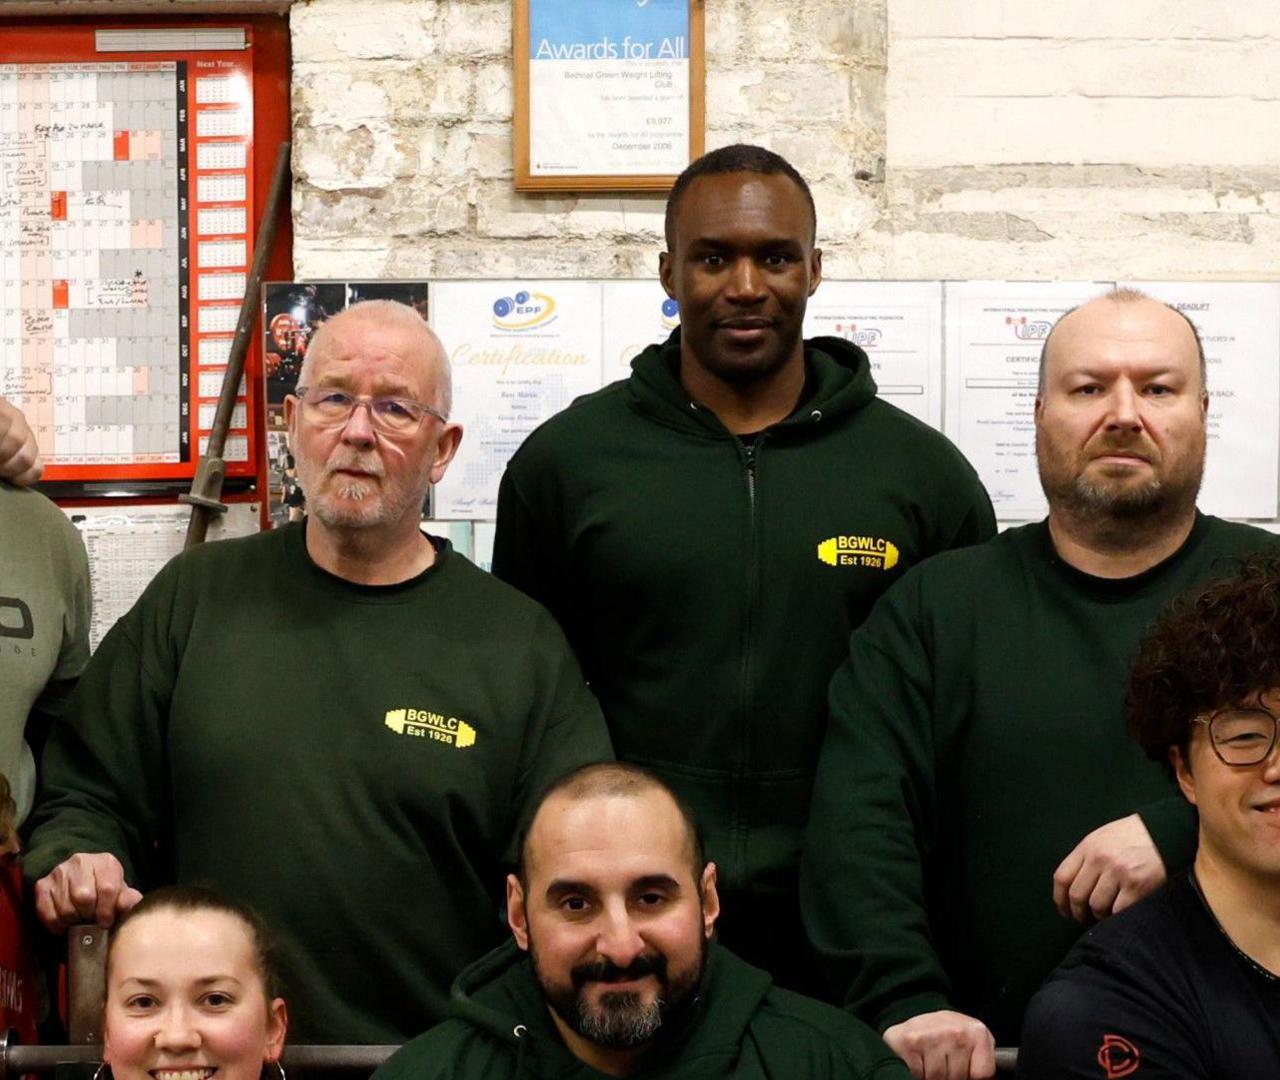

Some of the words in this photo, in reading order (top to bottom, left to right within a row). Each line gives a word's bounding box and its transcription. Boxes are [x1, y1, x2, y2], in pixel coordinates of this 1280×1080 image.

[535, 37, 618, 59] Awards
[622, 36, 653, 59] for
[657, 36, 684, 58] All
[197, 60, 215, 68] Next
[621, 70, 648, 80] Weight
[649, 71, 673, 80] Lifting
[654, 81, 673, 89] Club
[612, 142, 651, 151] December
[516, 306, 542, 315] EPF
[1177, 303, 1210, 311] DEADLIFT
[451, 344, 590, 377] Certification
[1006, 356, 1040, 364] CERTIFIC
[838, 535, 885, 552] BGWLC
[840, 555, 858, 566] Est
[407, 708, 458, 730] BGWLC
[406, 726, 426, 738] Est
